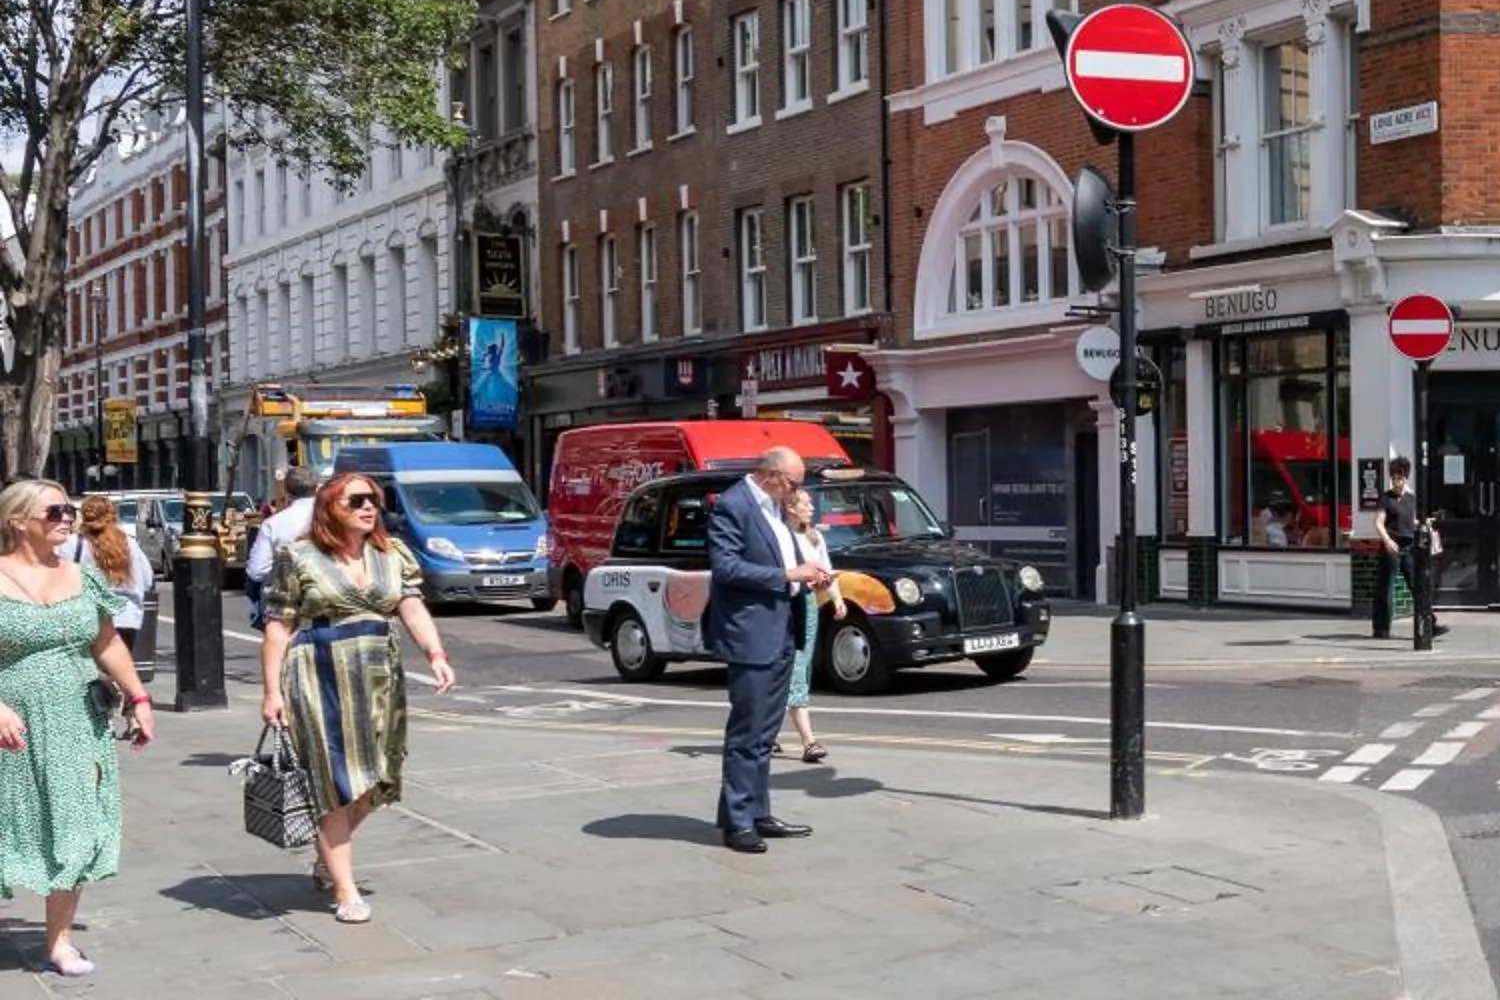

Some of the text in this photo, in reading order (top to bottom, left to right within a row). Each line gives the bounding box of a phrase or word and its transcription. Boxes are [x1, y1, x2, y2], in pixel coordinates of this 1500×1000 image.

[1374, 115, 1393, 131] LONG
[1395, 110, 1413, 125] ACRE
[1205, 289, 1278, 318] BENUGO
